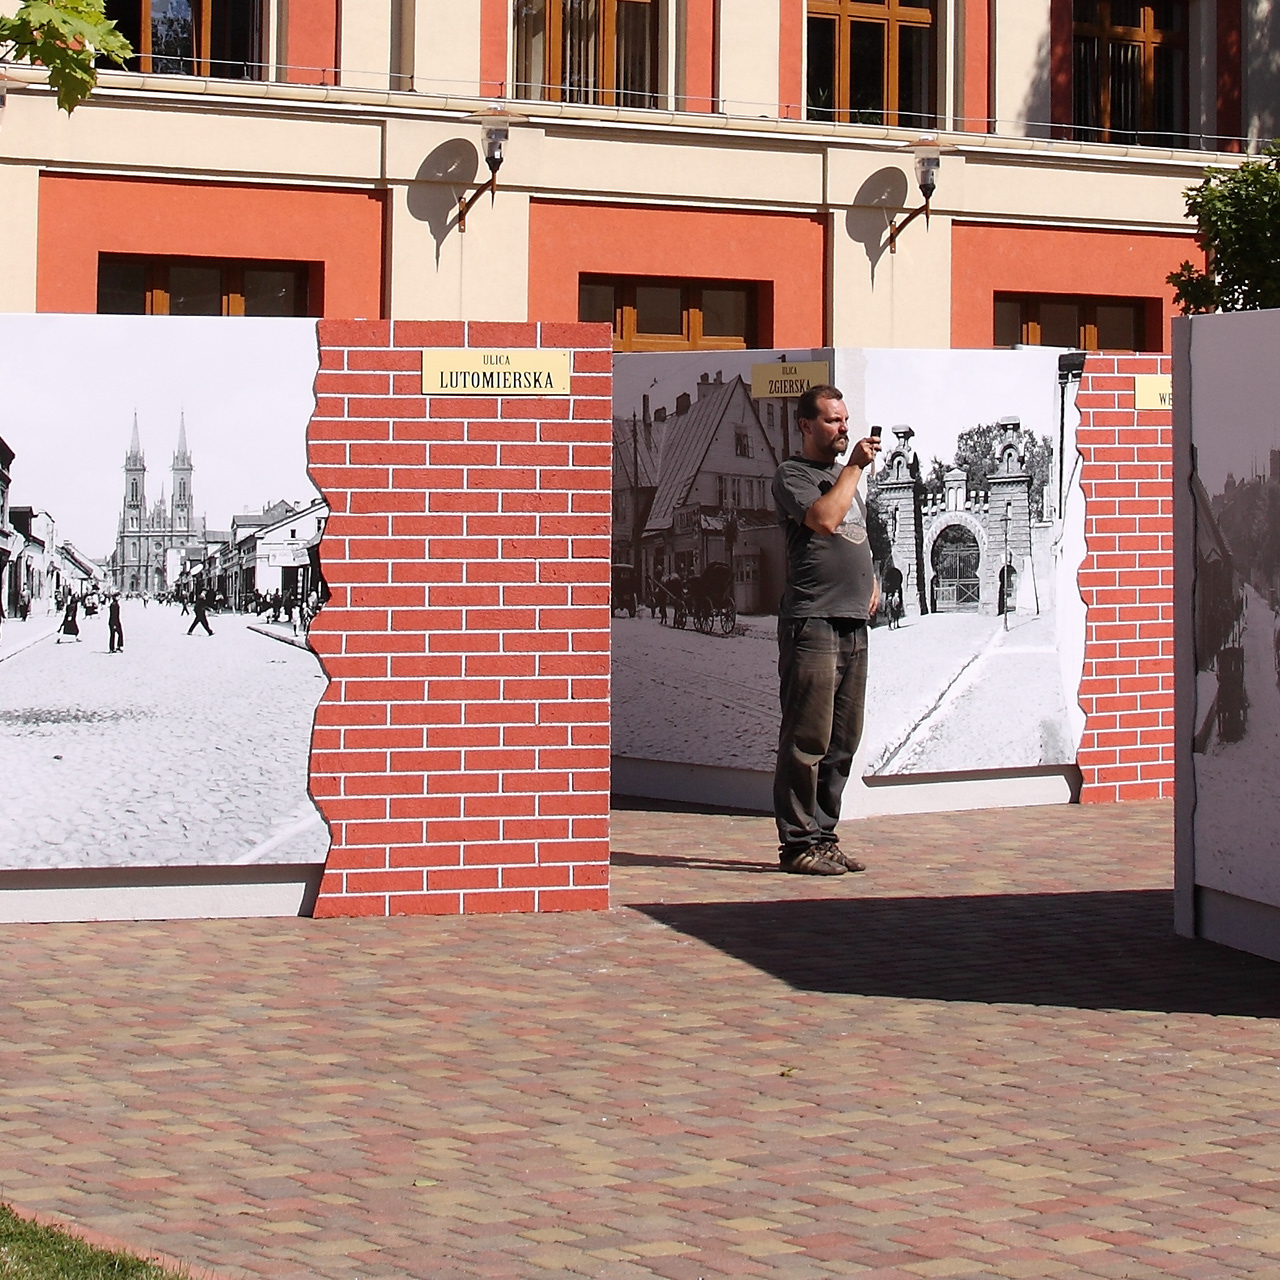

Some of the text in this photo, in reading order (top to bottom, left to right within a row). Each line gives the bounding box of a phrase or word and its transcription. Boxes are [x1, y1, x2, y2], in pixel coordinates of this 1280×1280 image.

[483, 354, 511, 366] ULICA
[781, 366, 797, 375] ULICA
[439, 371, 554, 389] LUTOMIERSKA
[768, 379, 811, 394] ZGIERSKA
